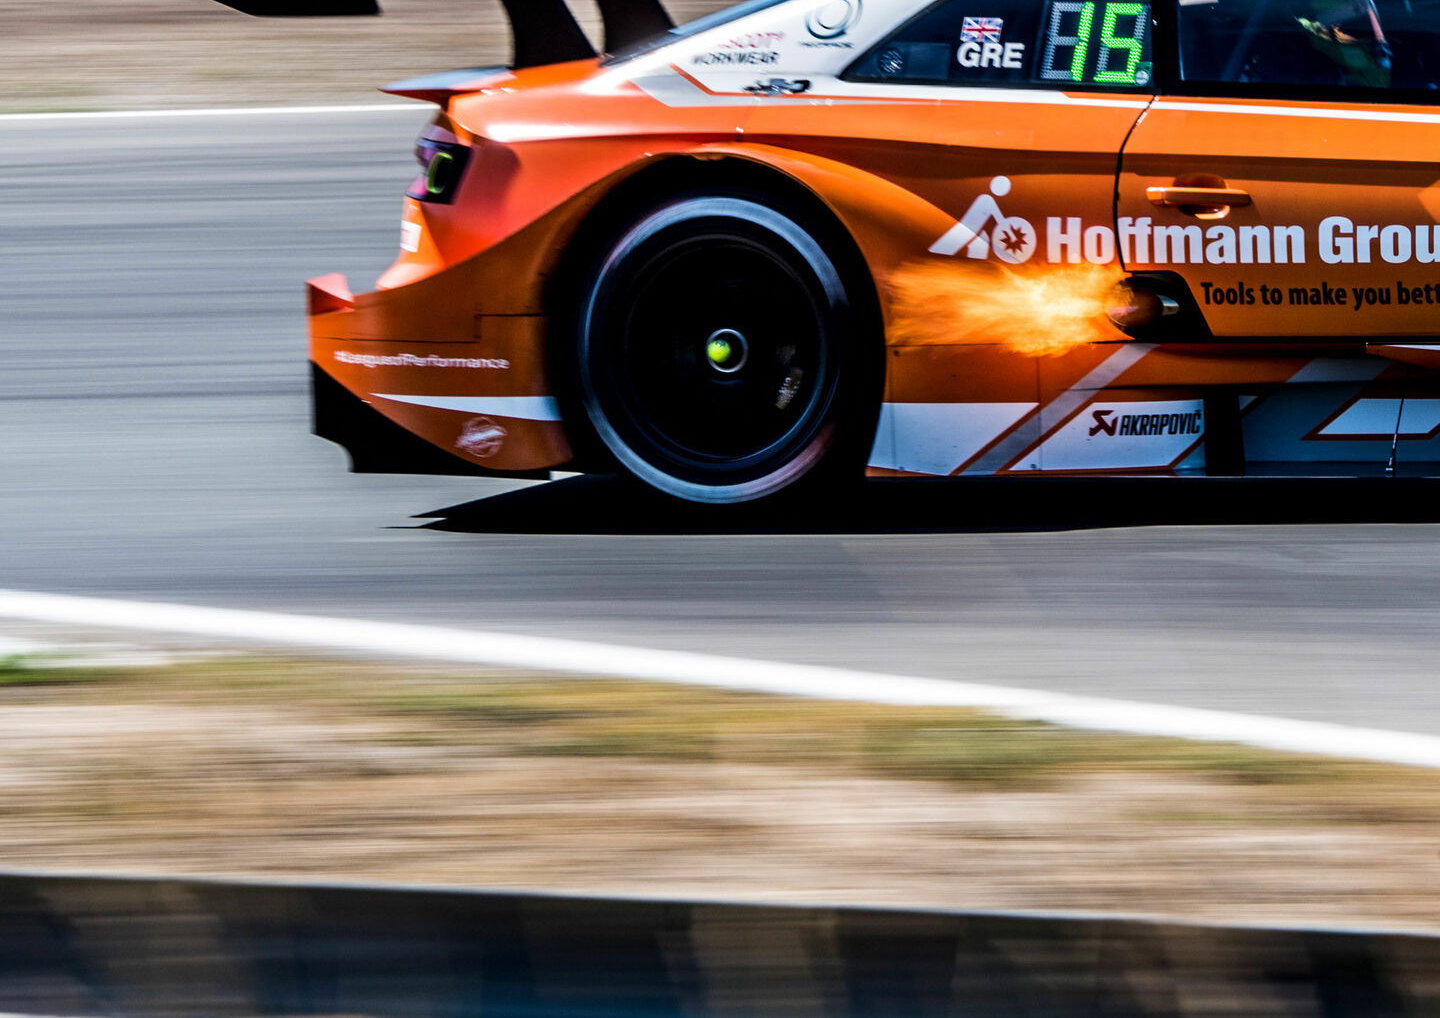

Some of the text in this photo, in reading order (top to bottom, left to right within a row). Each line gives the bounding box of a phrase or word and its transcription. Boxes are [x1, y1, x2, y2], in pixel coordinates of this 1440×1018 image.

[957, 42, 1025, 68] GRE
[1071, 1, 1144, 83] 15
[1046, 216, 1306, 264] Hoffmann
[1201, 282, 1254, 305] Tools
[1259, 284, 1283, 305] to
[1289, 282, 1347, 305] make
[1352, 286, 1391, 311] you
